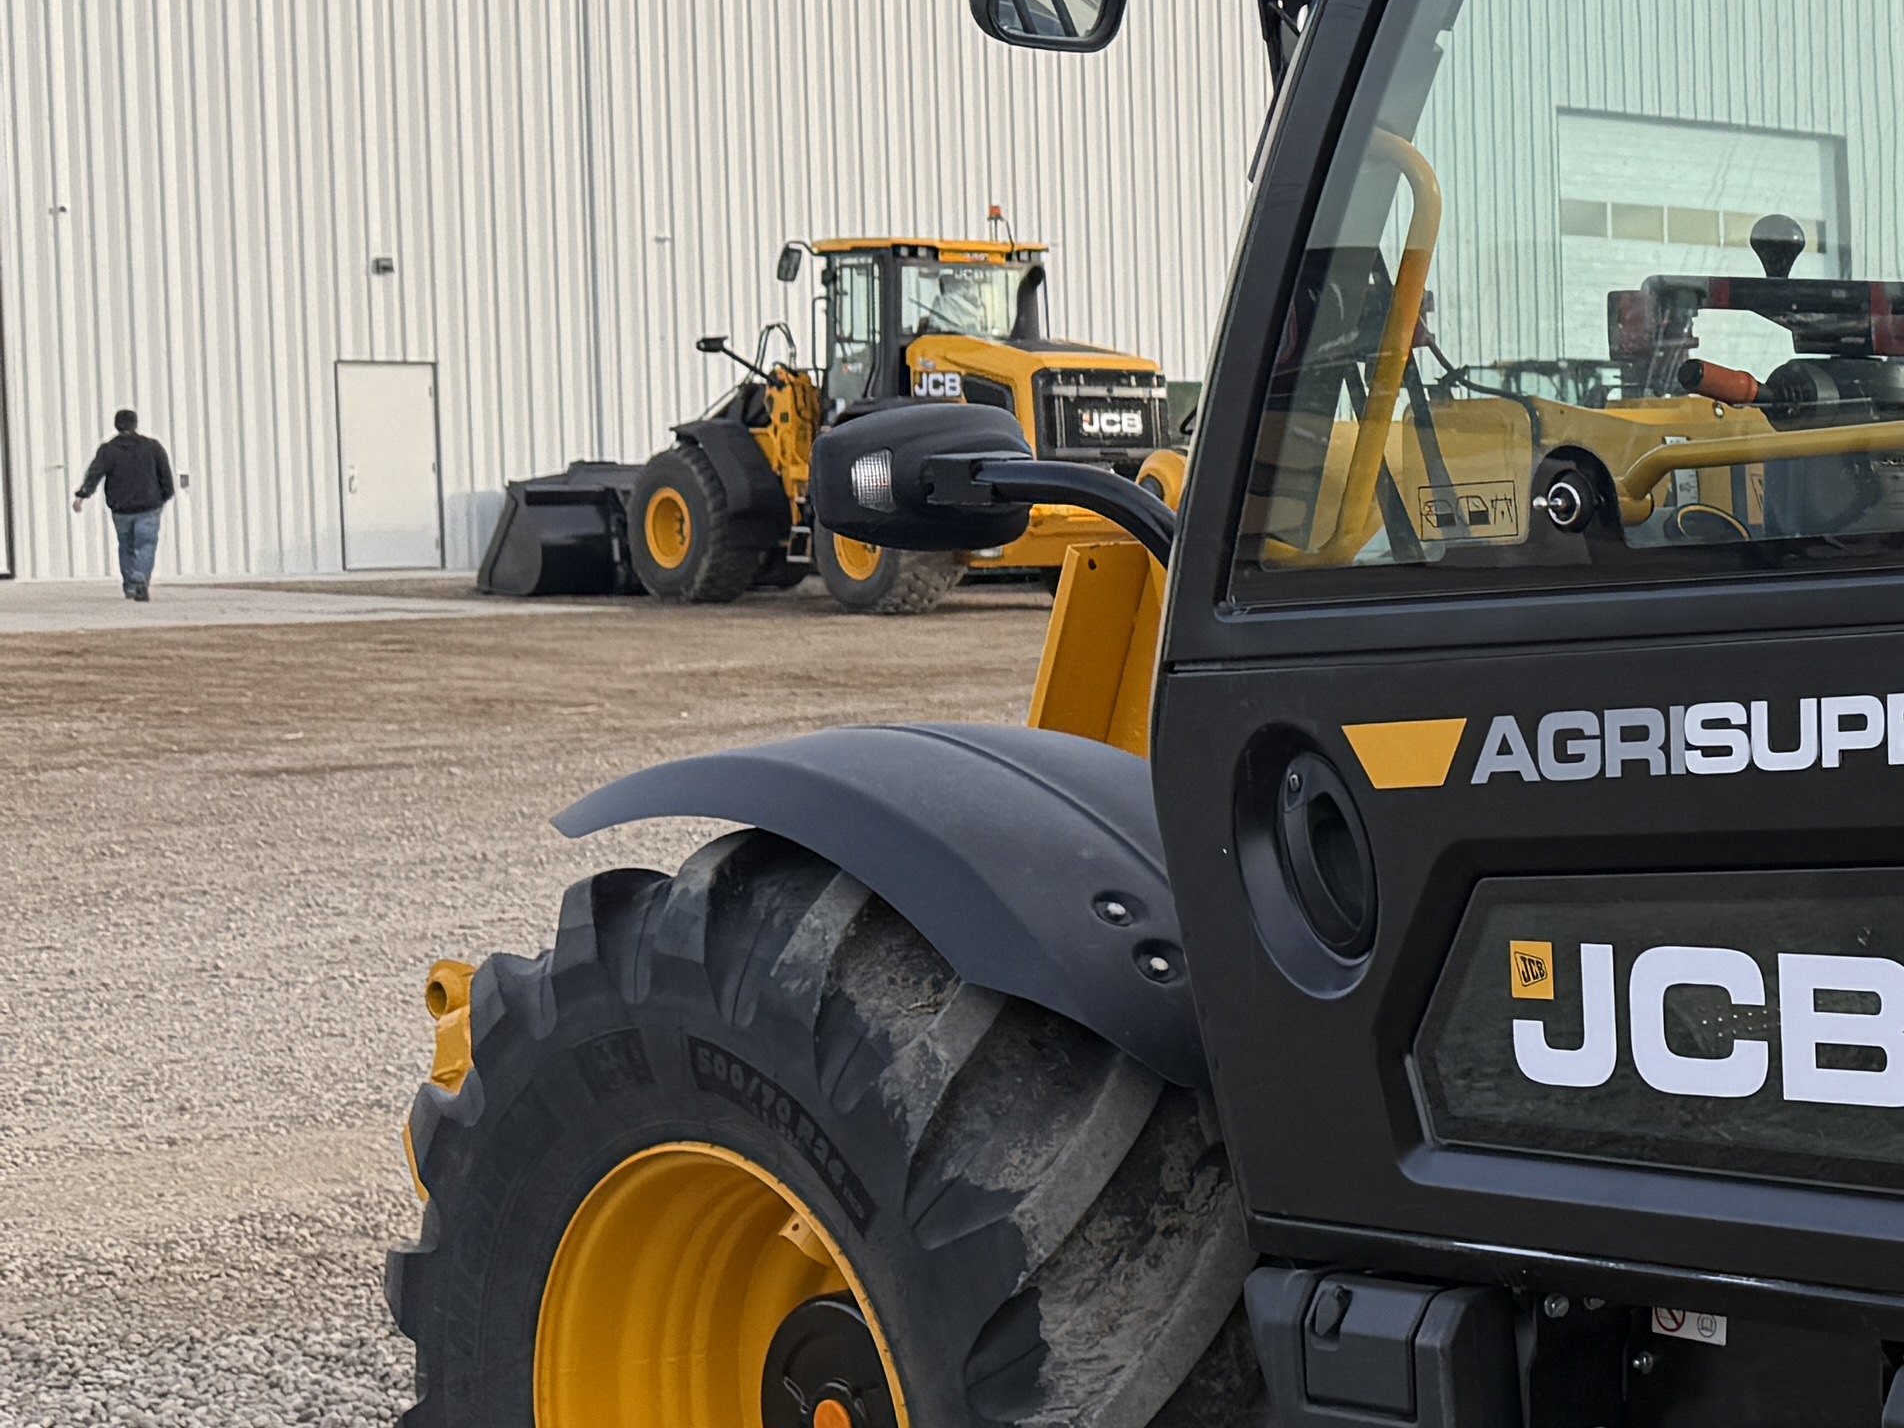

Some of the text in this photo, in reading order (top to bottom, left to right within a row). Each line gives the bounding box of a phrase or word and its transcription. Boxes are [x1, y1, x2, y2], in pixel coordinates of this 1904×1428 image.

[914, 373, 961, 397] JCB
[1080, 410, 1143, 435] JCB
[1519, 954, 1546, 984] JCB
[695, 1047, 792, 1124] 500/70
